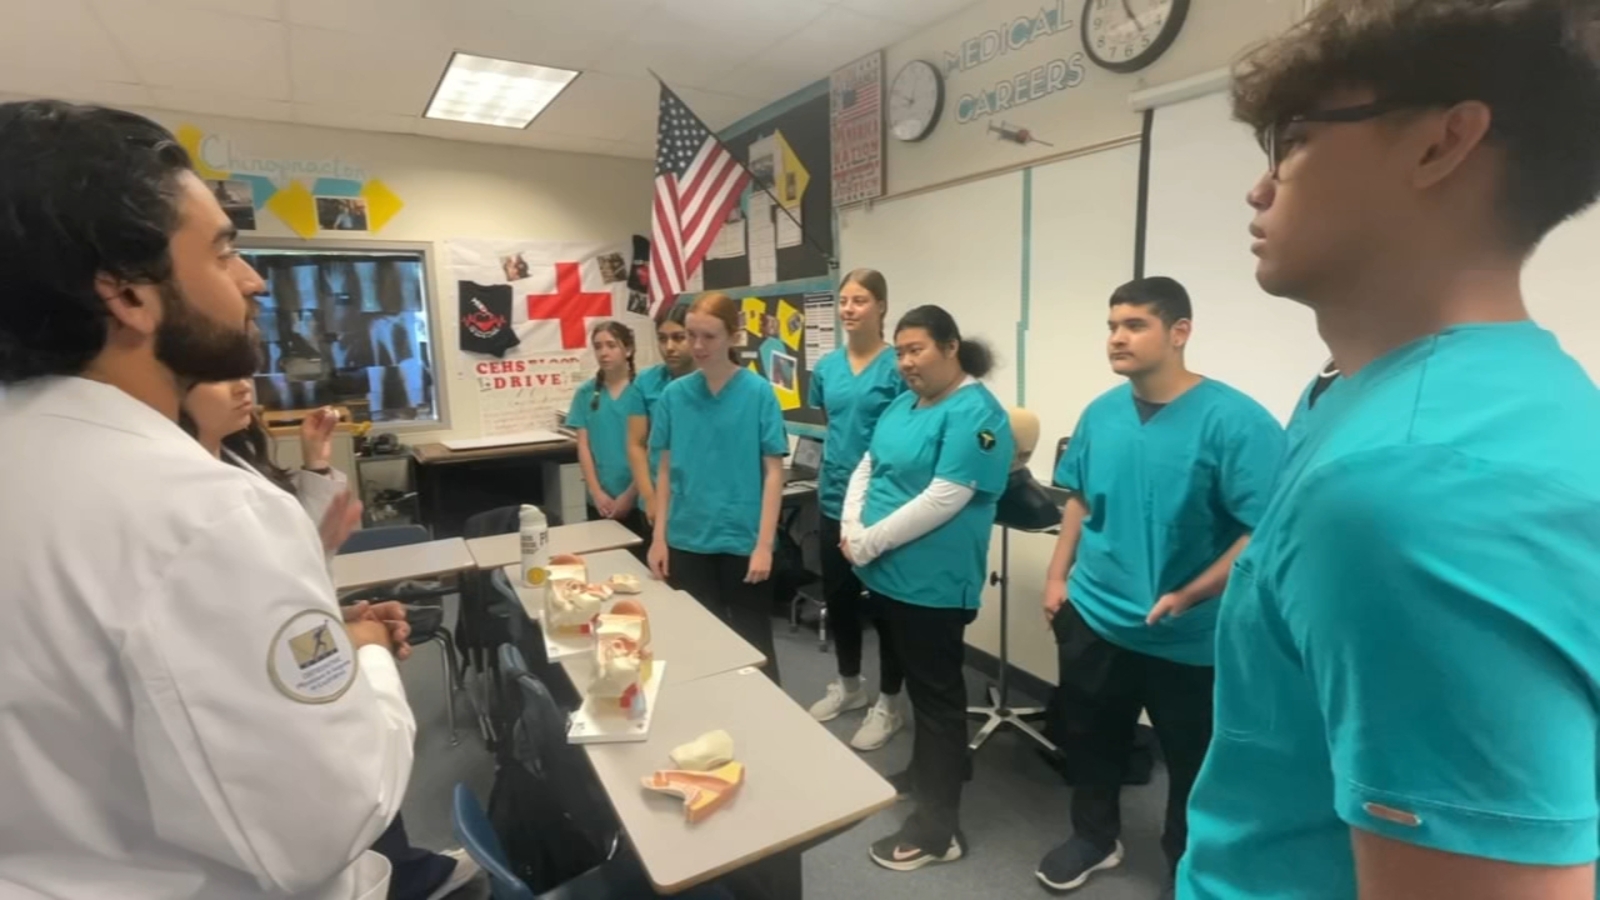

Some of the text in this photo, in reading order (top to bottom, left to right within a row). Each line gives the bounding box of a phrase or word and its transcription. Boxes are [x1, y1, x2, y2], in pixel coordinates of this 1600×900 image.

[943, 0, 1073, 79] MEDICAL
[1108, 46, 1118, 58] 7
[1124, 44, 1134, 57] 6
[955, 52, 1086, 124] CAREERS
[476, 360, 526, 375] CEHS
[494, 373, 561, 389] DRIVE
